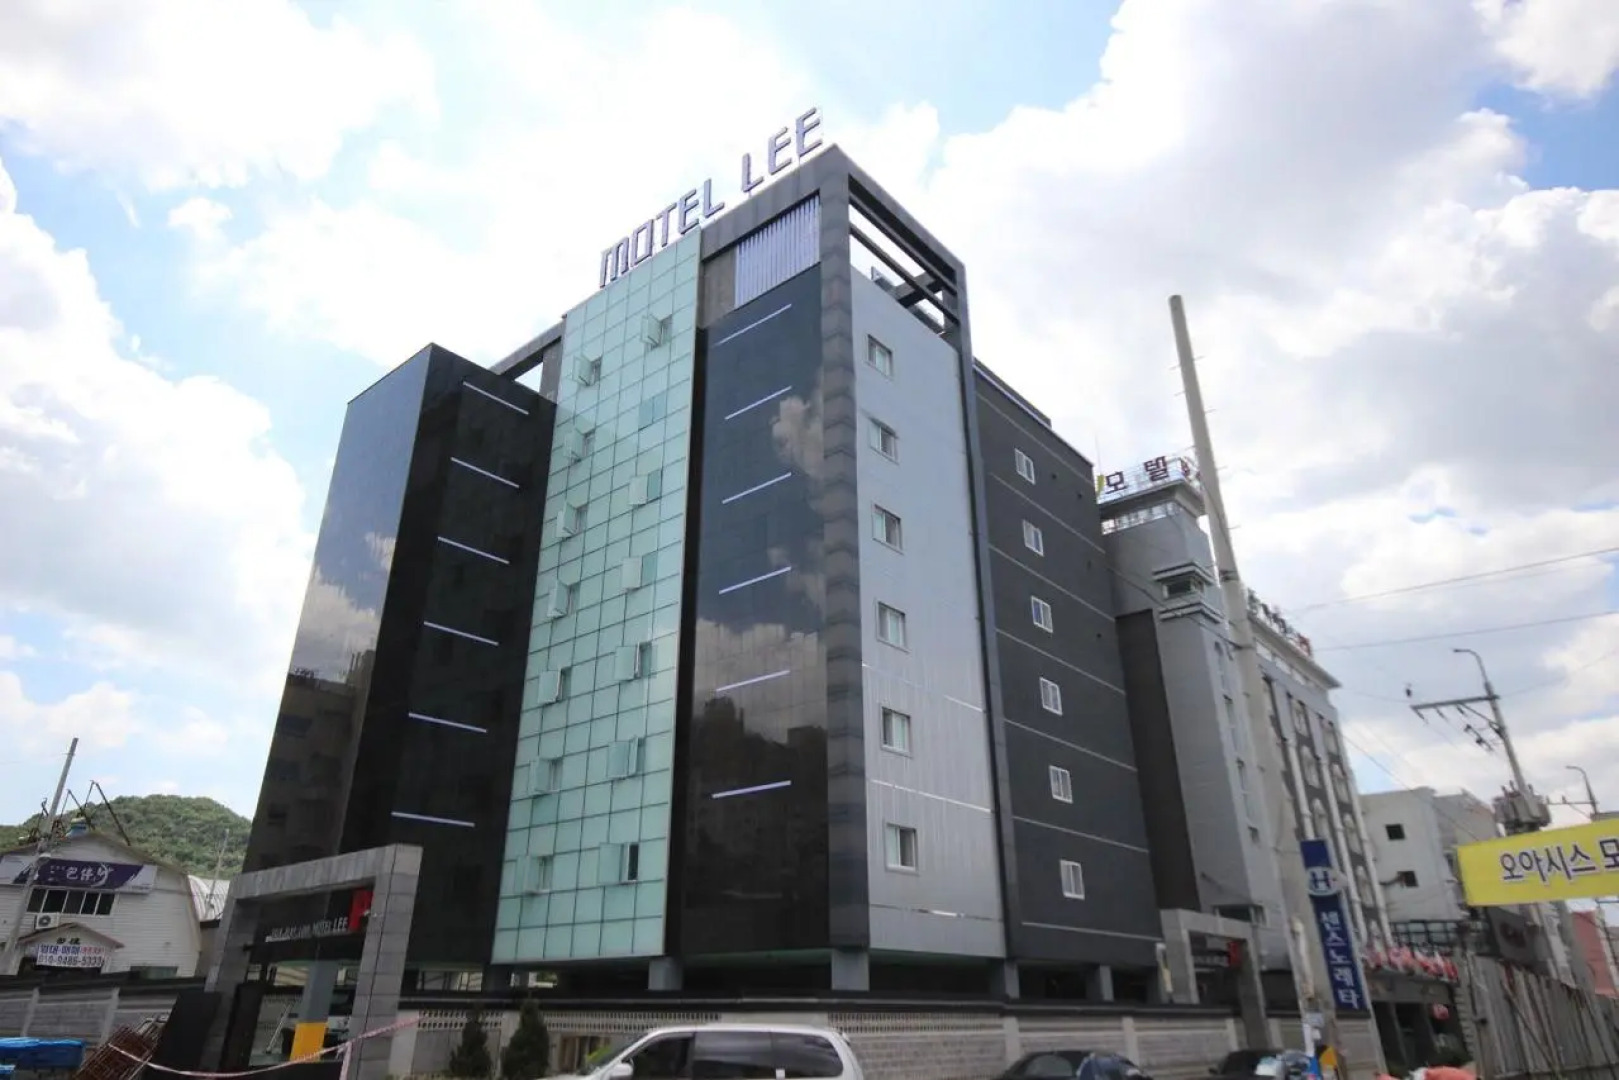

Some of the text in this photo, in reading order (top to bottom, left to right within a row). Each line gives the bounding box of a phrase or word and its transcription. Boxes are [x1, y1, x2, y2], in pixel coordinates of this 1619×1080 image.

[600, 107, 823, 288] MOTEL LEE
[1105, 456, 1169, 494] 모텔
[1500, 844, 1596, 882] 오아시스
[333, 917, 348, 932] LEE
